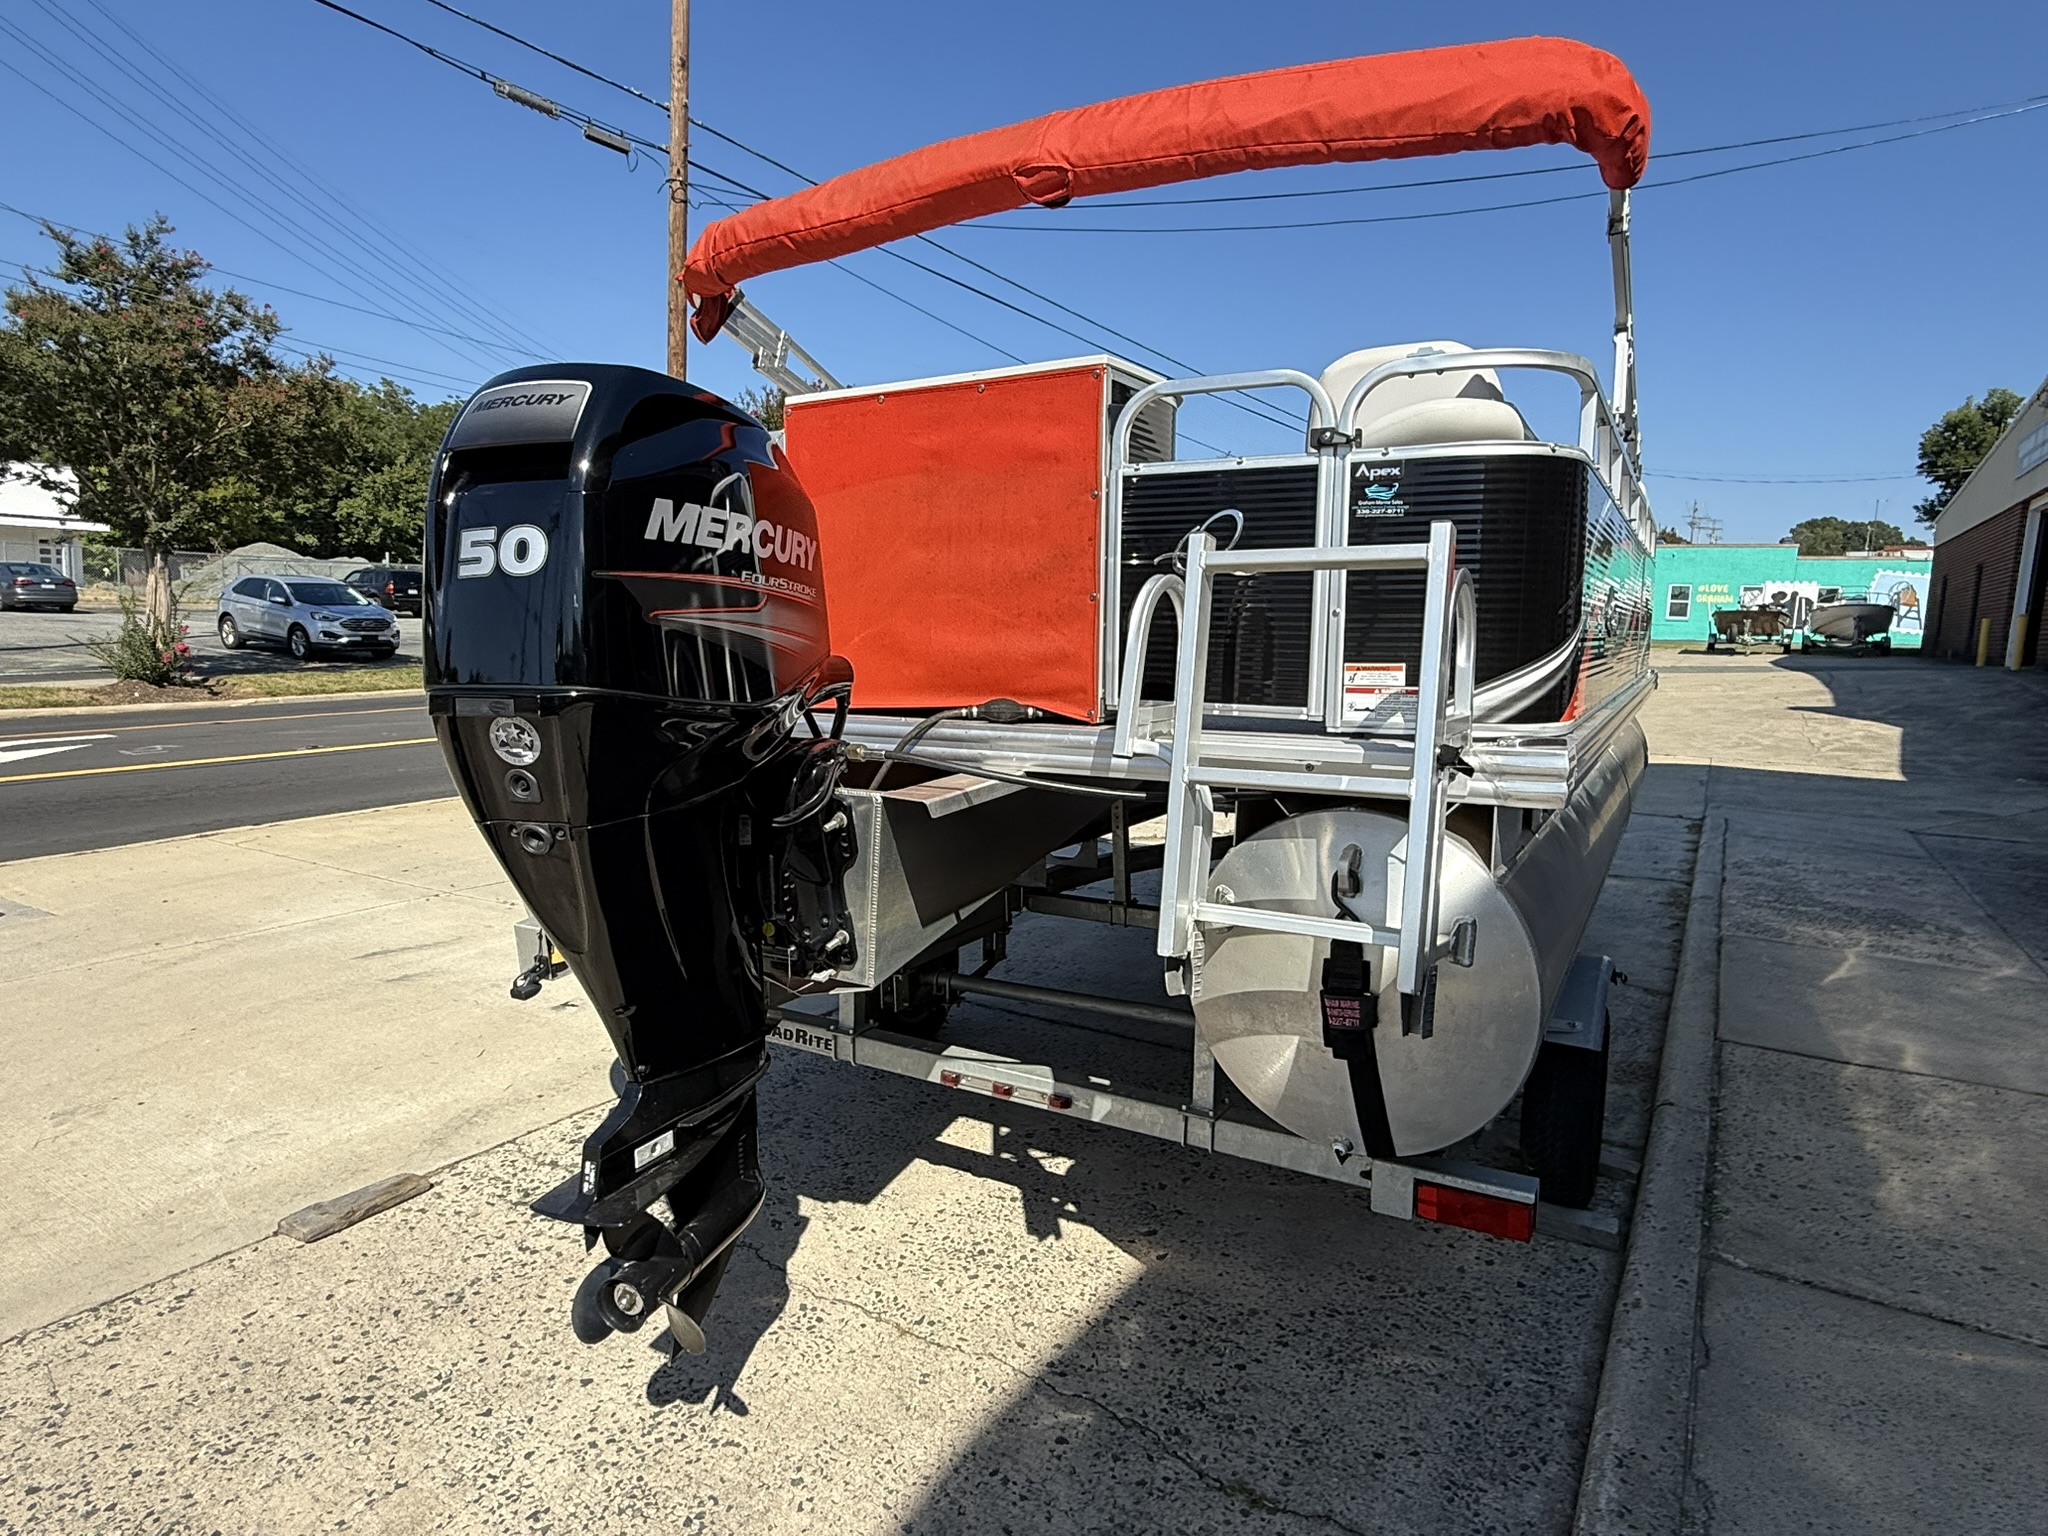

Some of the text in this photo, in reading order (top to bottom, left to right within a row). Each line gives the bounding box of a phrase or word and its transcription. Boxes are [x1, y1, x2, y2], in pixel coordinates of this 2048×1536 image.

[472, 394, 575, 413] MERCURY
[1355, 463, 1401, 481] Apex
[457, 523, 549, 579] 50
[644, 498, 817, 571] MERCURY
